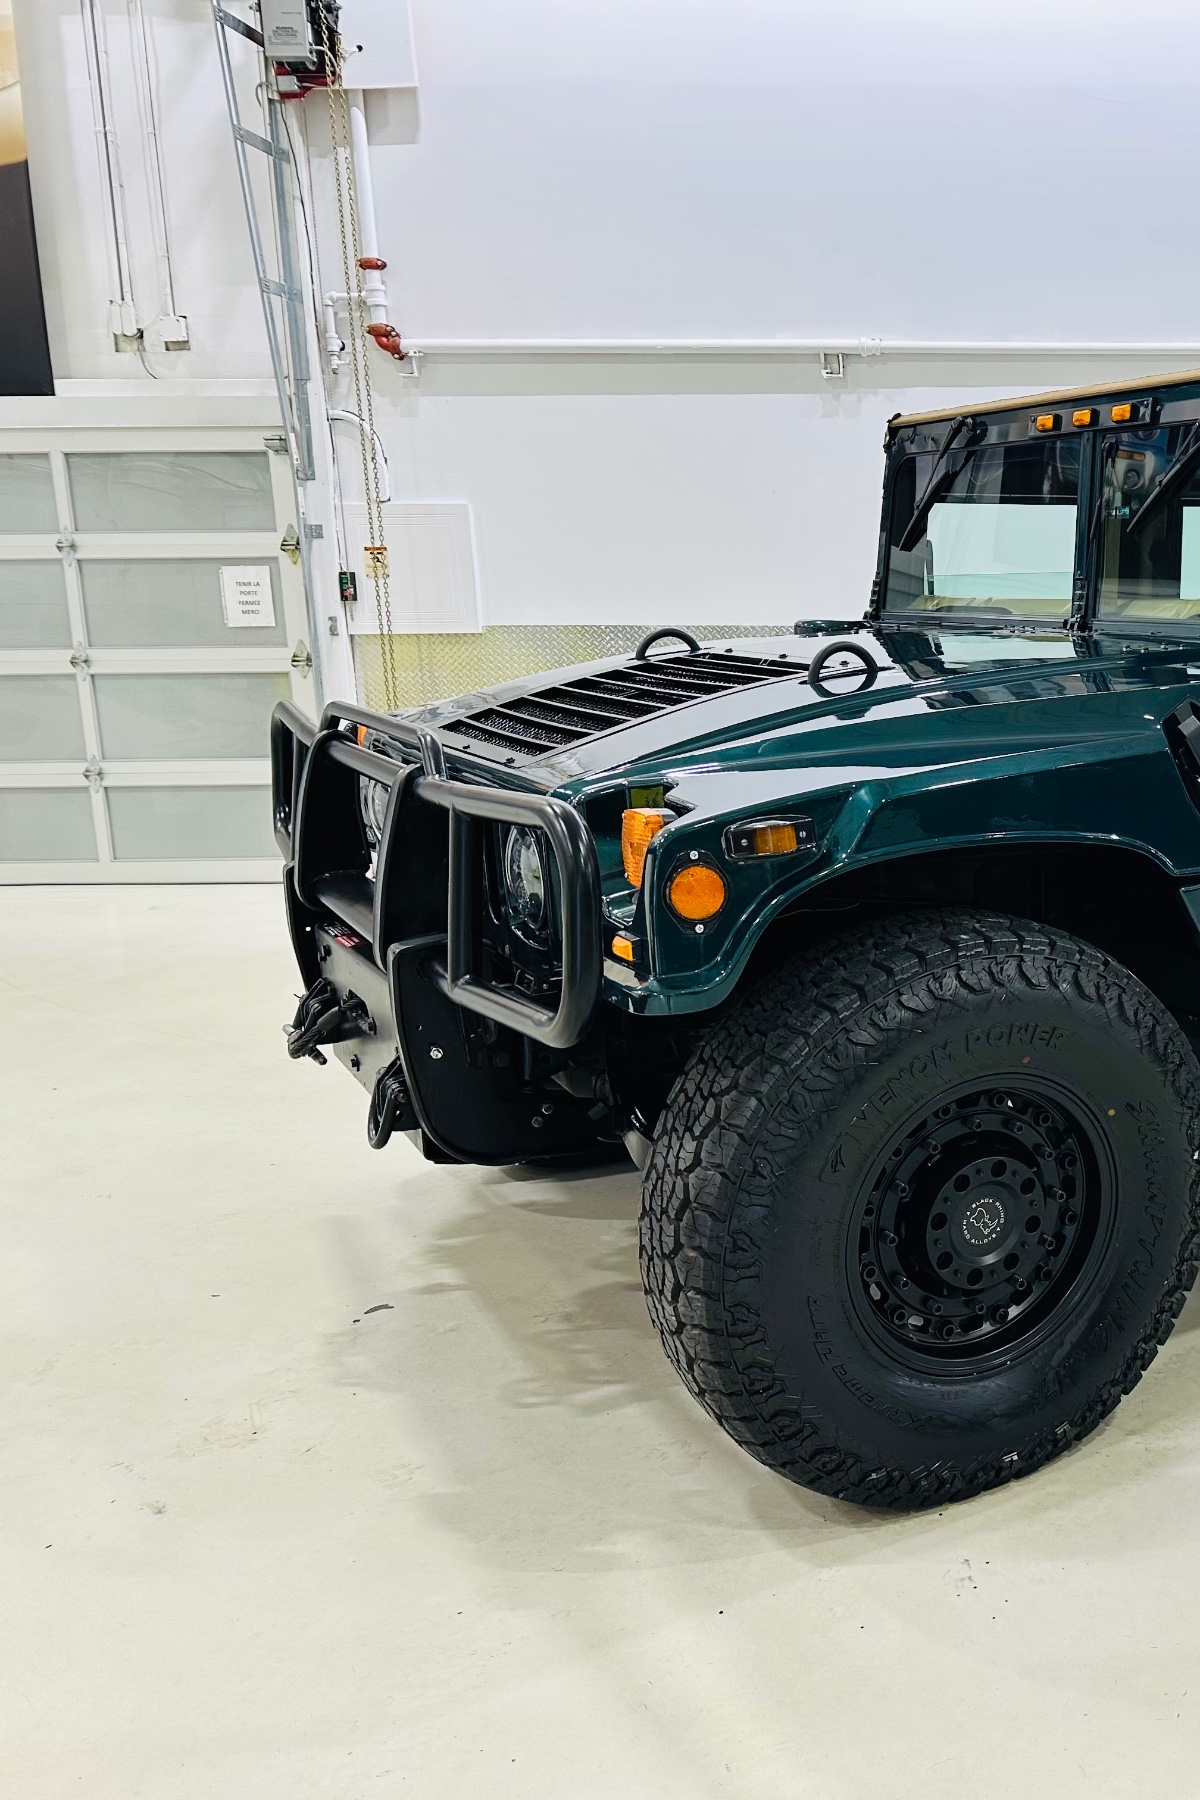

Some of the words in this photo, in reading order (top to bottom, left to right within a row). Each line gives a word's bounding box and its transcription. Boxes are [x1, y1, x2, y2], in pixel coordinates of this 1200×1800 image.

[849, 1038, 952, 1132] VENOM
[964, 1021, 1072, 1056] POWER
[971, 1197, 994, 1209] BLACK
[994, 1201, 1005, 1224] RHINO
[962, 1219, 971, 1240] HARD
[970, 1233, 997, 1245] ALLOYS
